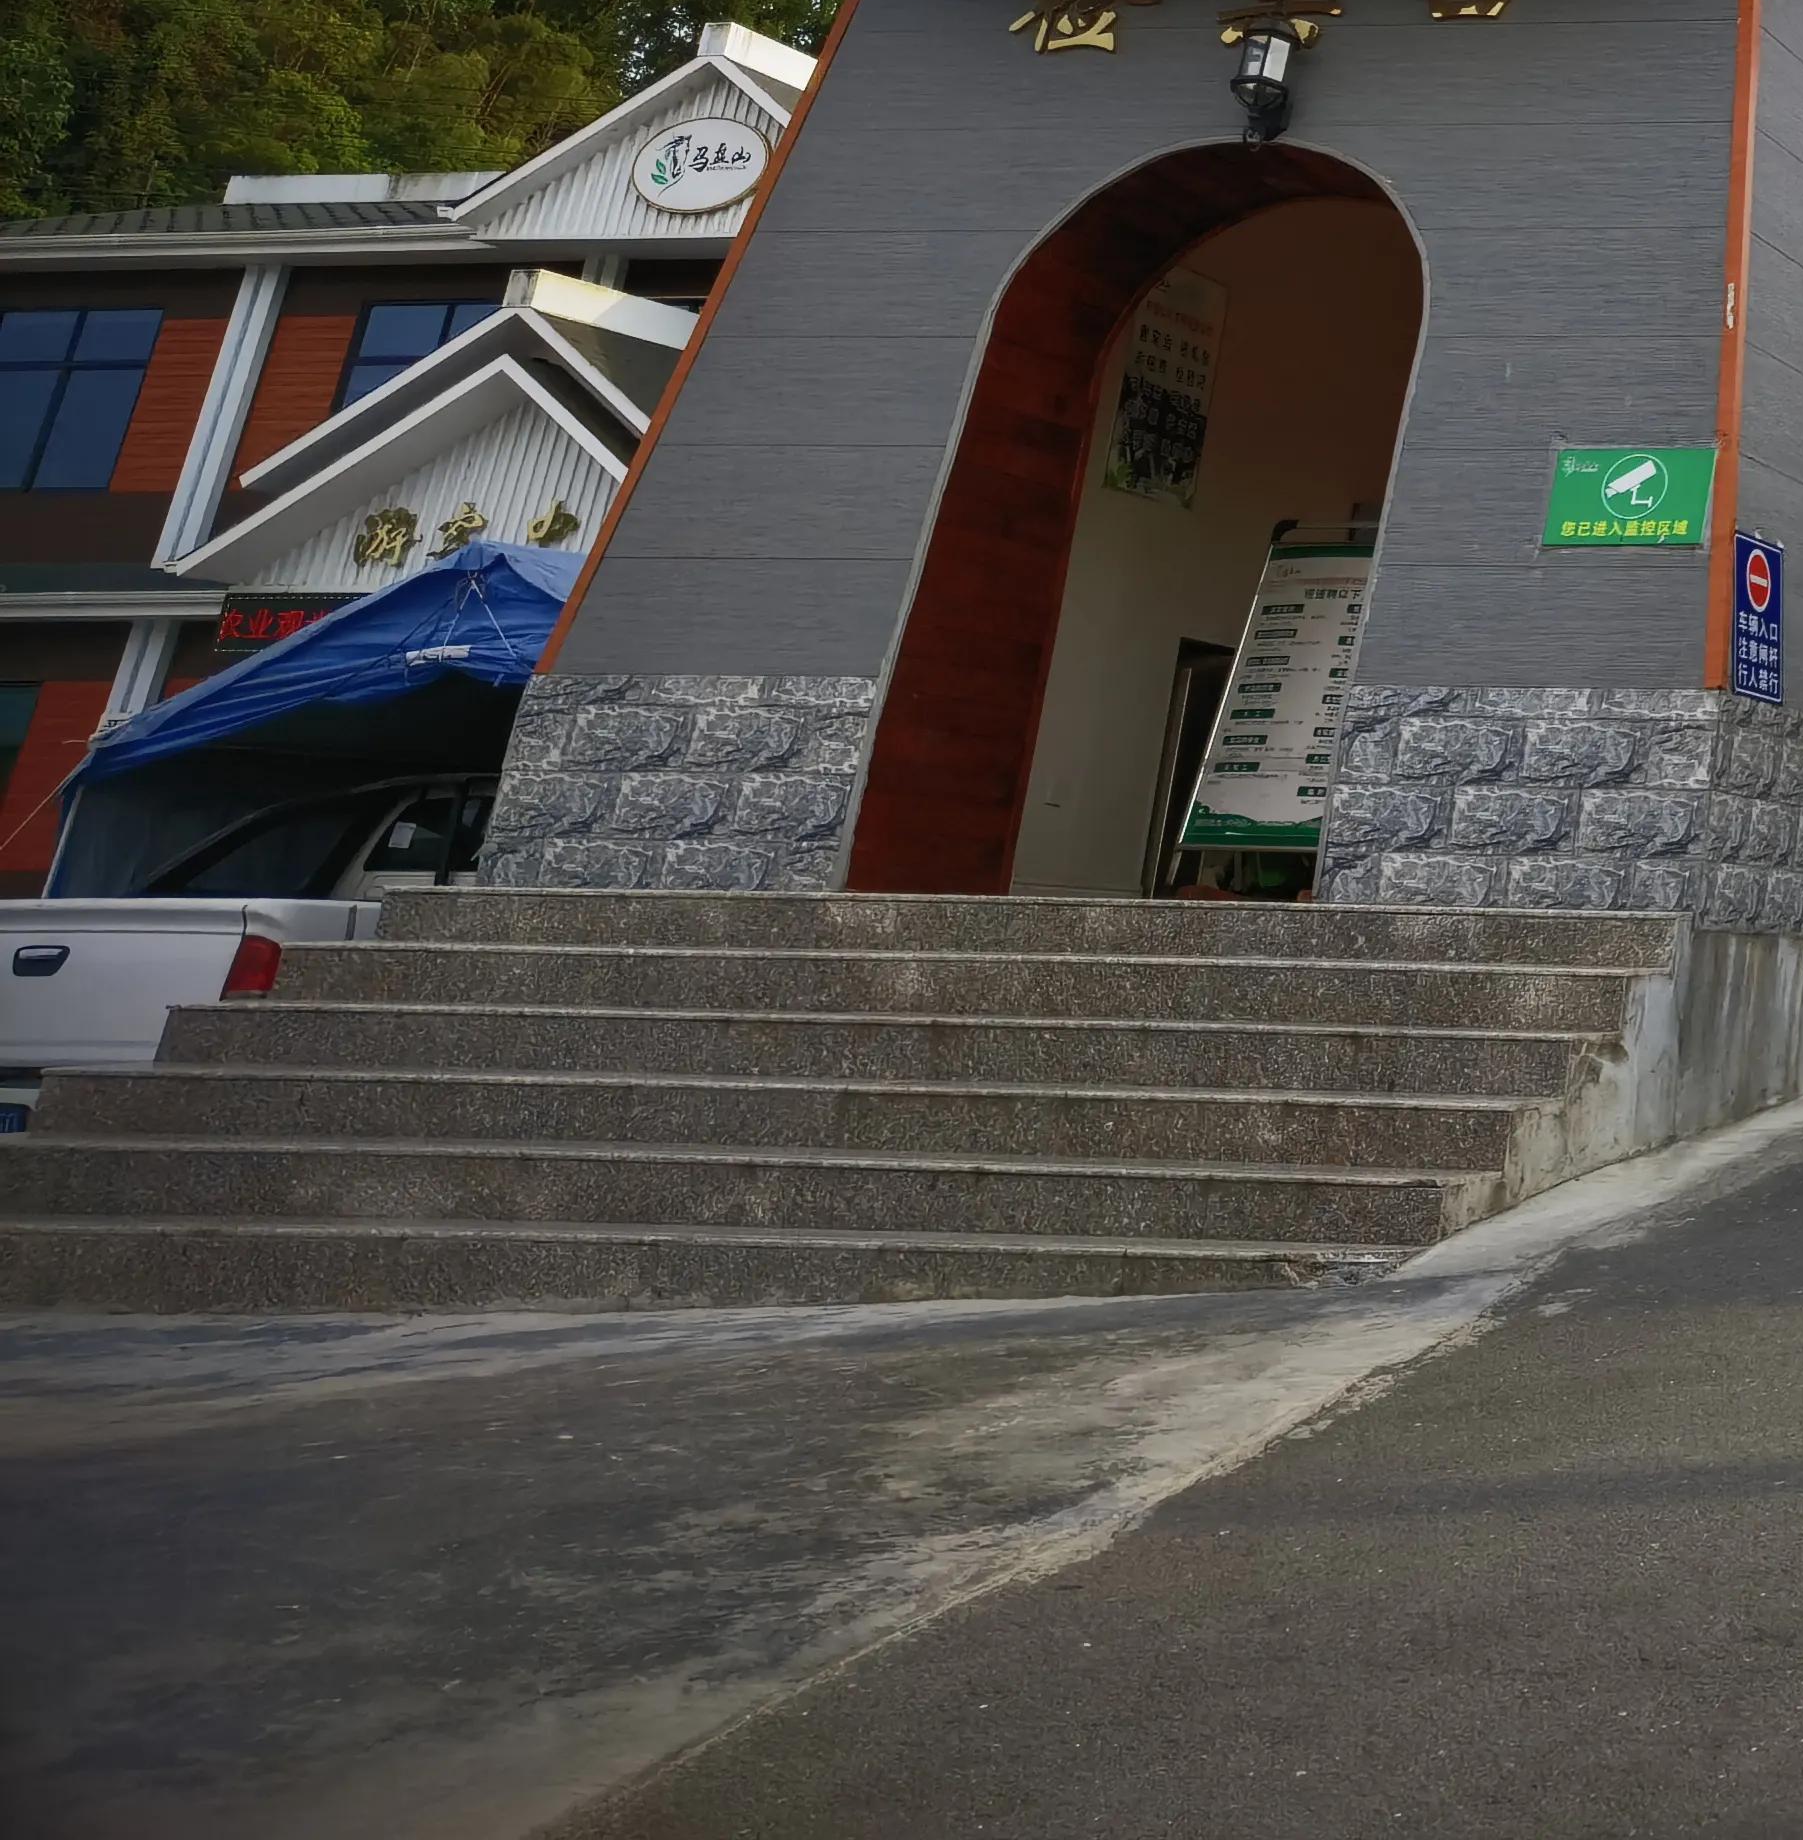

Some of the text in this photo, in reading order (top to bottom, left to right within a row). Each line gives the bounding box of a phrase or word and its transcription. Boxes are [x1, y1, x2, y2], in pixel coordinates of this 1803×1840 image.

[688, 142, 752, 172] 马盘山
[1560, 519, 1689, 537] 您已进入监控区域
[1738, 611, 1778, 642] 车辆入口
[1738, 662, 1778, 695] 行人禁行
